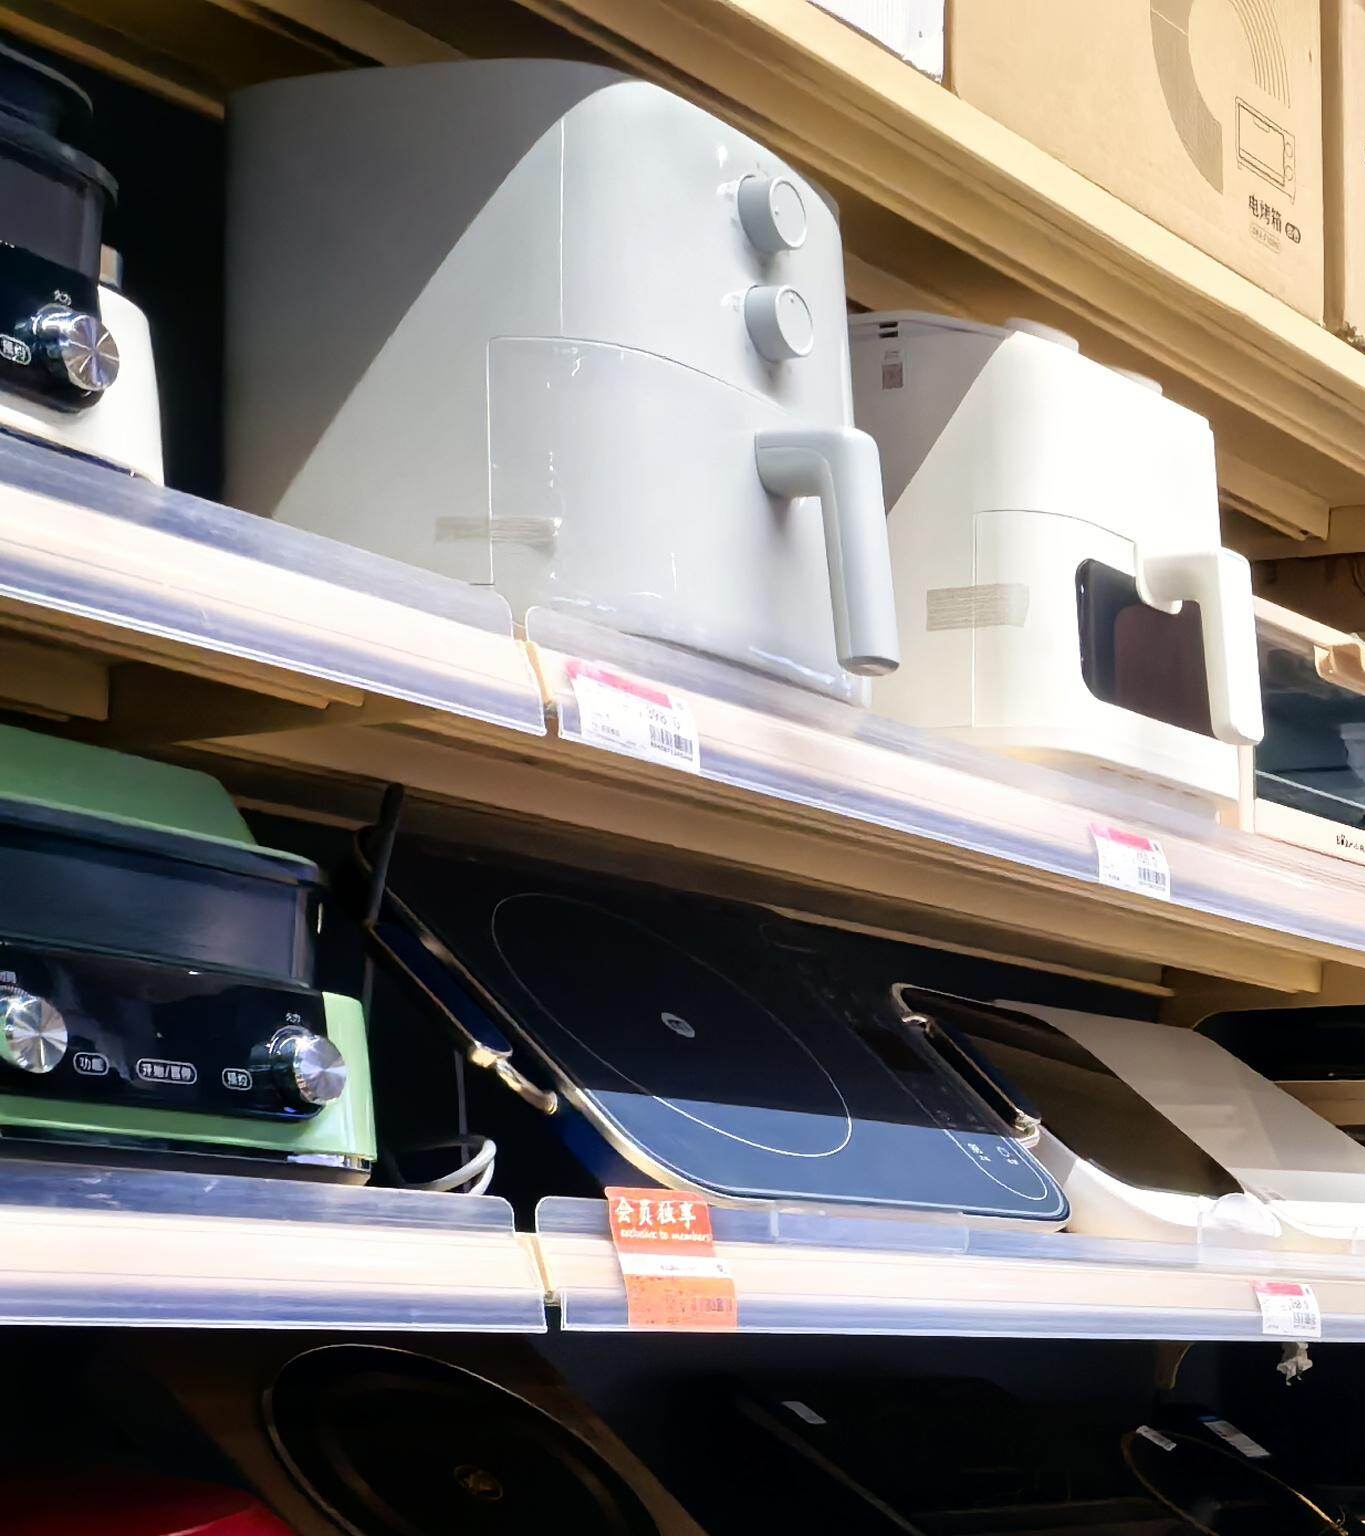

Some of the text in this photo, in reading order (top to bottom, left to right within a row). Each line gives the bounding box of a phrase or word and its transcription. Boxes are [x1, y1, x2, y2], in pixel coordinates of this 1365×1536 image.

[1248, 193, 1282, 234] 电烤箱
[615, 1197, 697, 1230] 会员独享
